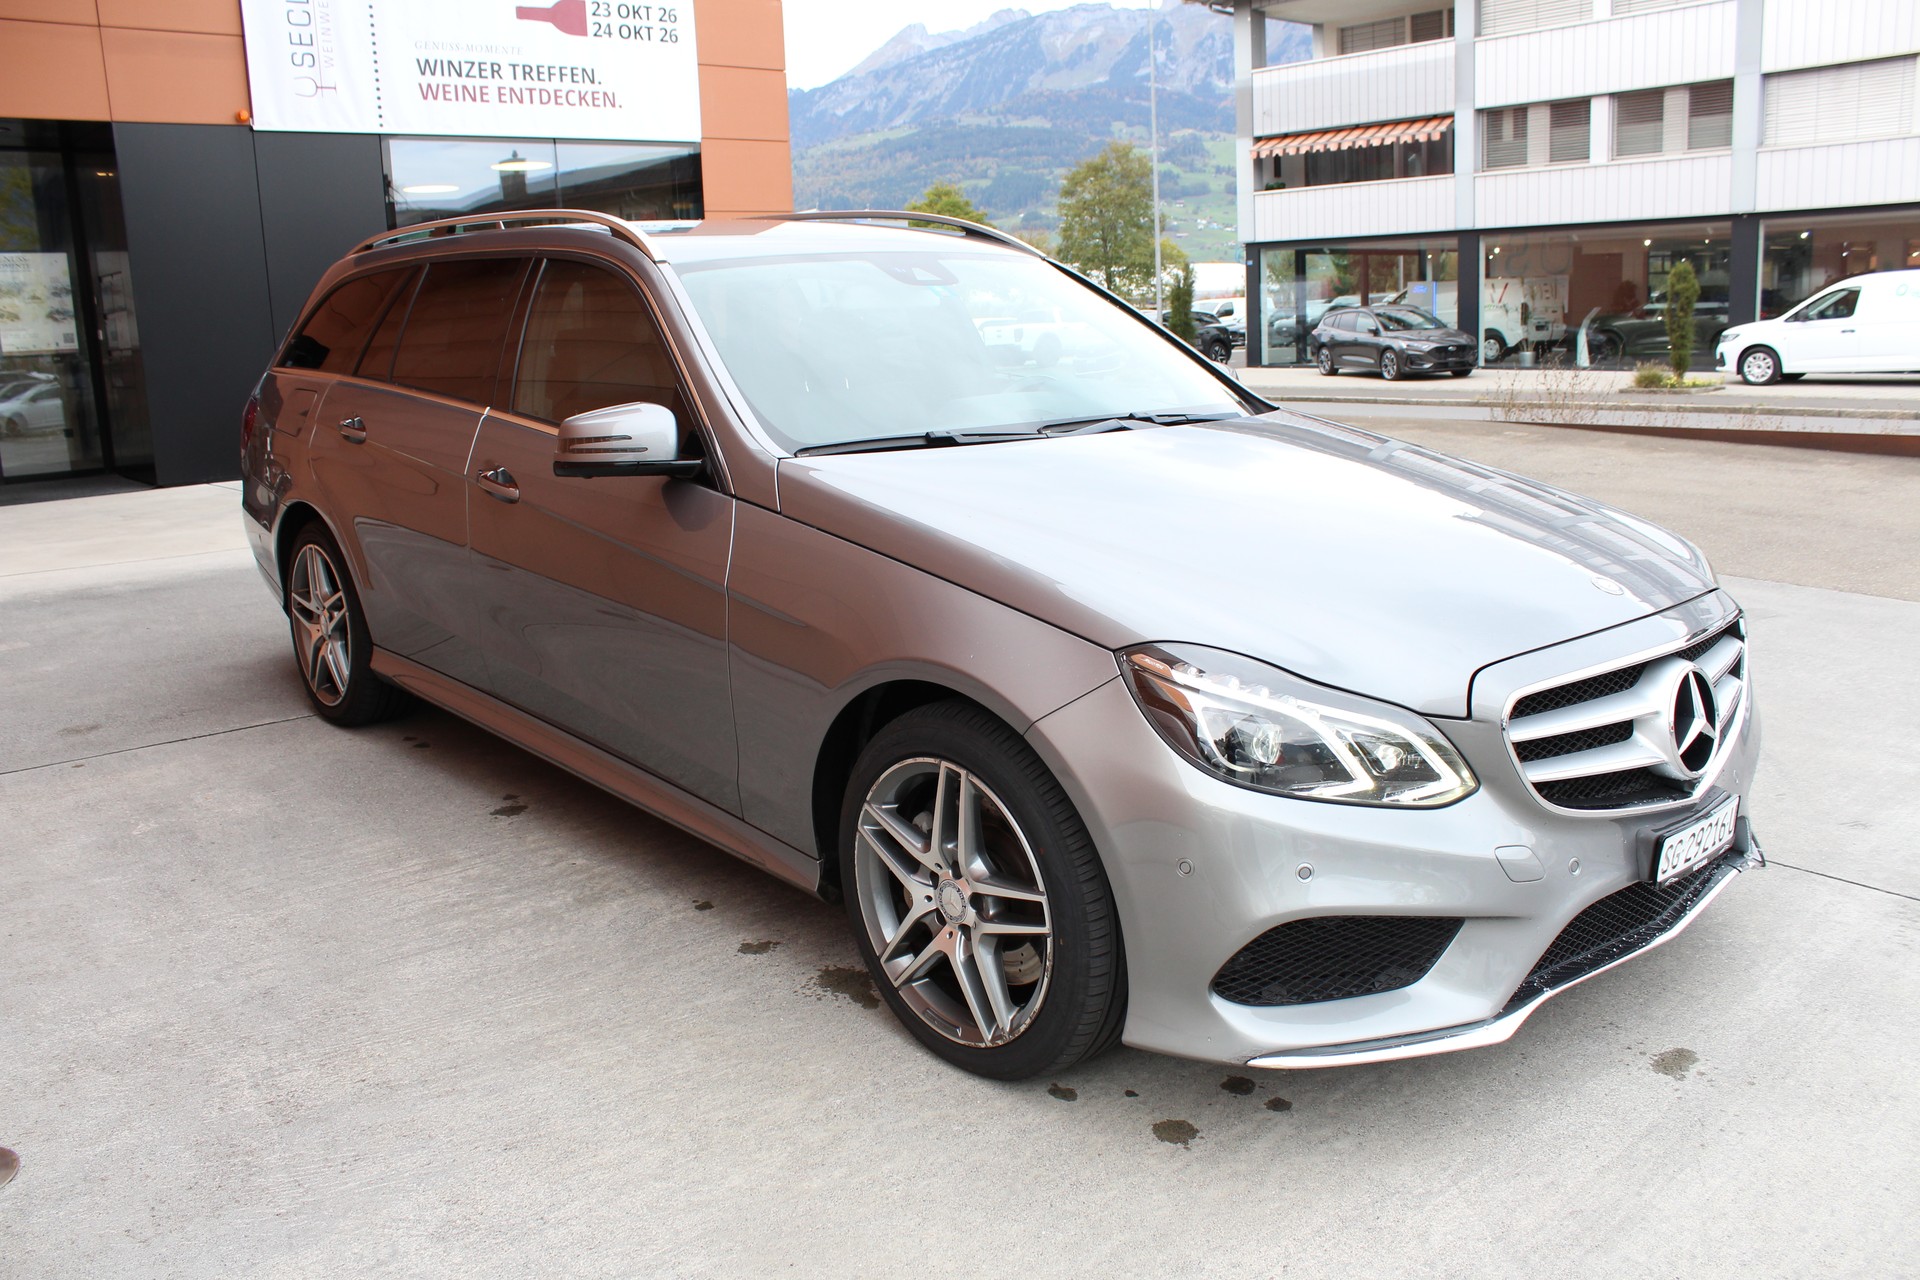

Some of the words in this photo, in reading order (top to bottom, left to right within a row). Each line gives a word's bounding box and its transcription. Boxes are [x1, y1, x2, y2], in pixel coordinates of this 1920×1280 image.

[591, 1, 611, 17] 23
[617, 3, 652, 21] OKT
[658, 7, 677, 23] 26
[592, 22, 613, 38] 24
[618, 24, 653, 41] OKT
[659, 27, 678, 43] 26
[414, 40, 524, 56] GENUSS-MOMENTE
[416, 58, 503, 80] WINZER
[509, 63, 602, 85] TREFFEN.
[418, 82, 490, 103] WEINE
[497, 86, 623, 108] ENTDECKEN.
